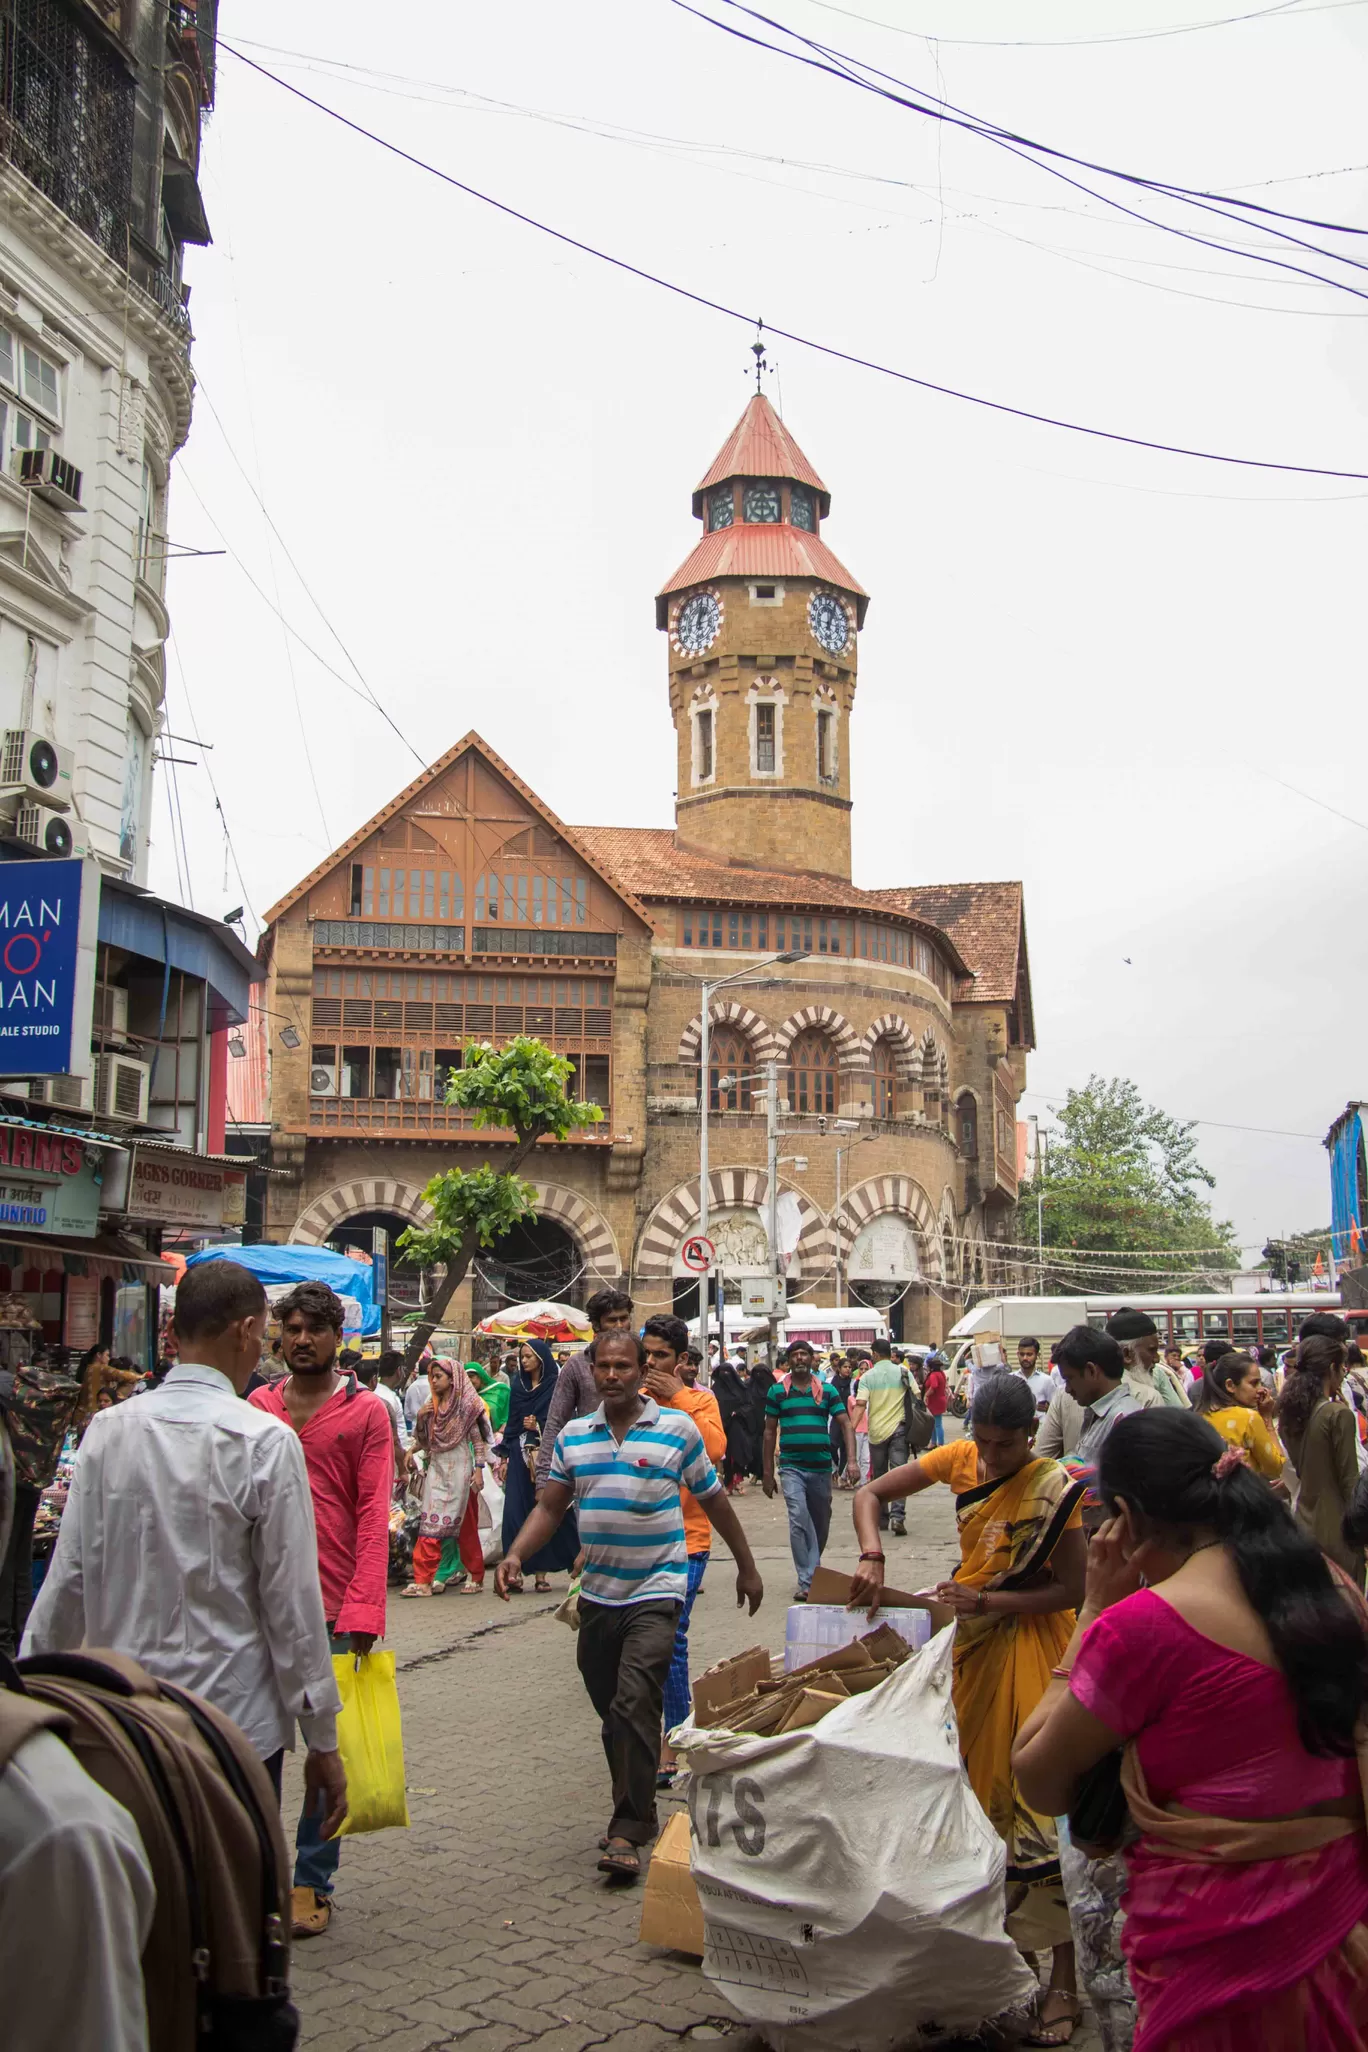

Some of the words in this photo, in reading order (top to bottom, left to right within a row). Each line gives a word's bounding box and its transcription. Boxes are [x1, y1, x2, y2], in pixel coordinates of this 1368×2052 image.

[0, 979, 56, 1008] AN
[22, 1025, 60, 1036] STUDIO
[788, 1968, 800, 1979] 10
